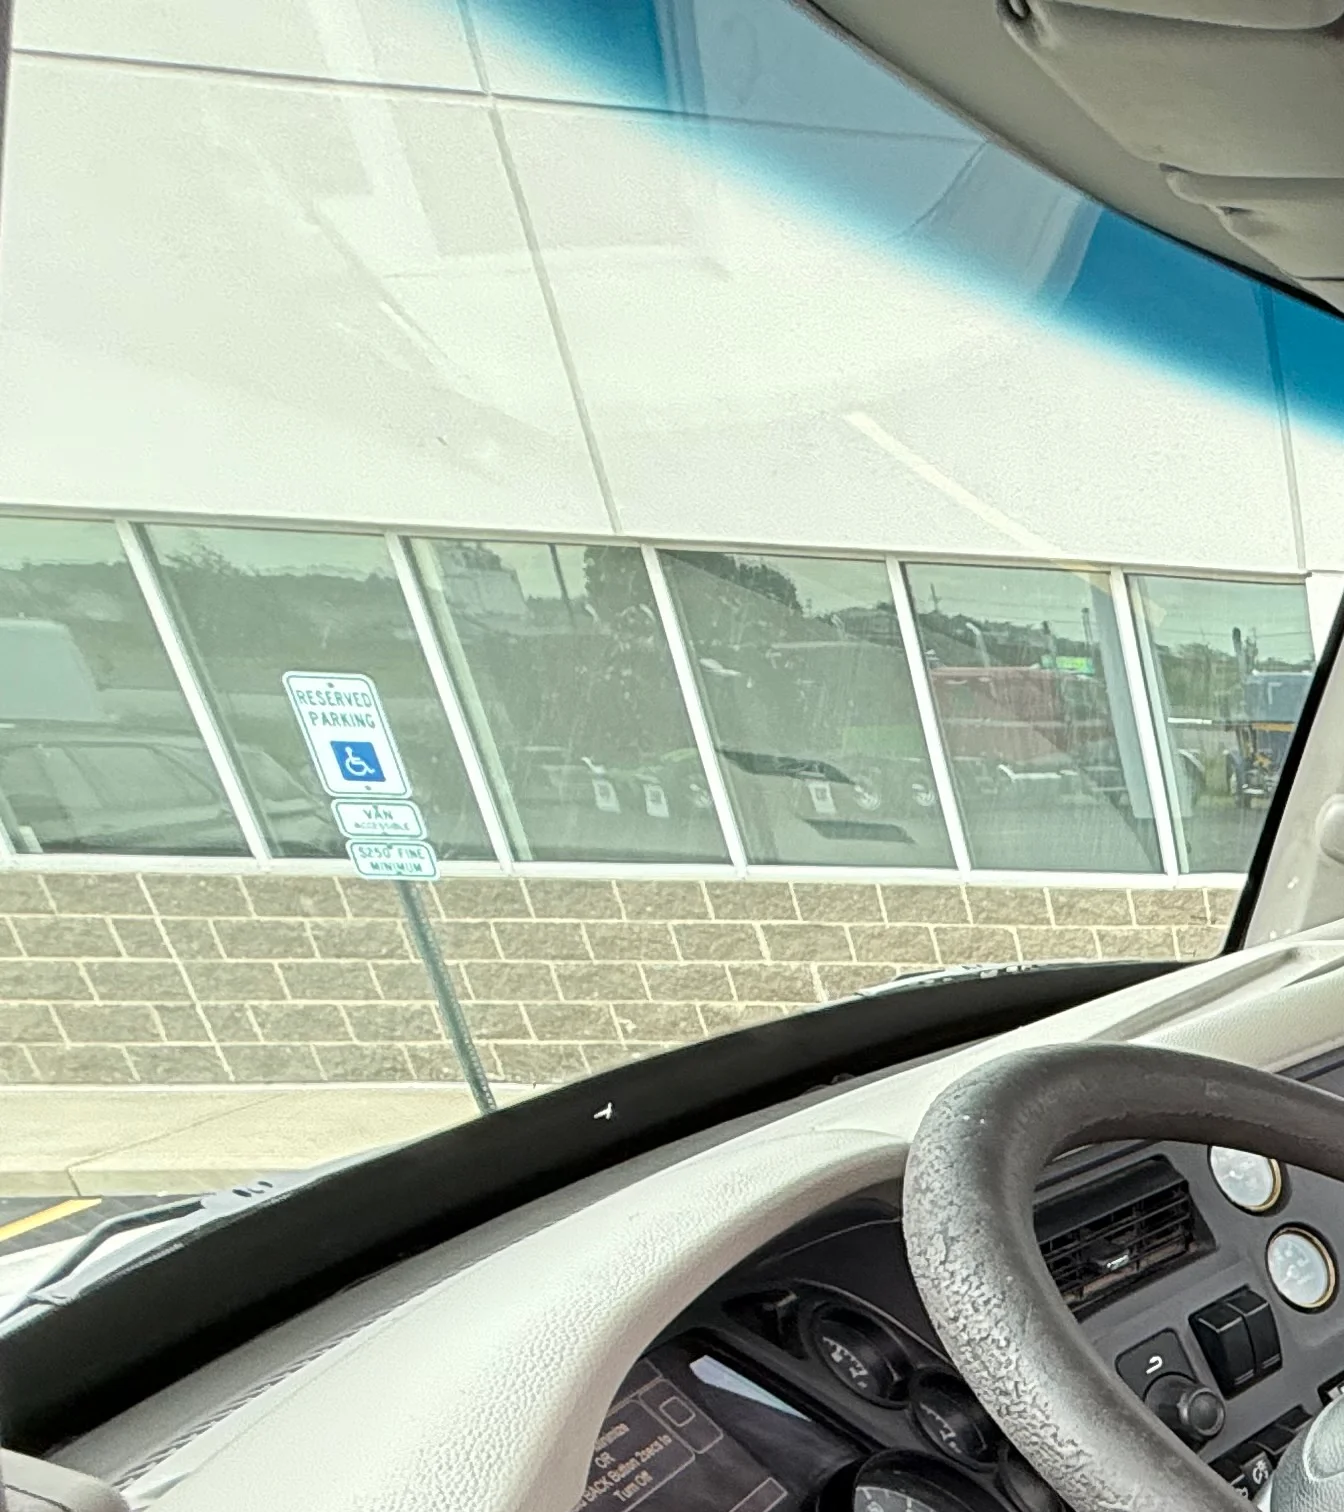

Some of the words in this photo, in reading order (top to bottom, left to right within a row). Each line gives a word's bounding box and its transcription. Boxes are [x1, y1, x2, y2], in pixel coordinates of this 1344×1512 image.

[296, 690, 373, 707] RESERVED
[308, 711, 375, 729] PARKING
[363, 809, 394, 821] VAN
[358, 846, 391, 860] $250
[397, 847, 426, 860] FINE
[370, 861, 423, 873] MINIMUM
[594, 1451, 616, 1469] OR
[613, 1483, 639, 1503] Turn
